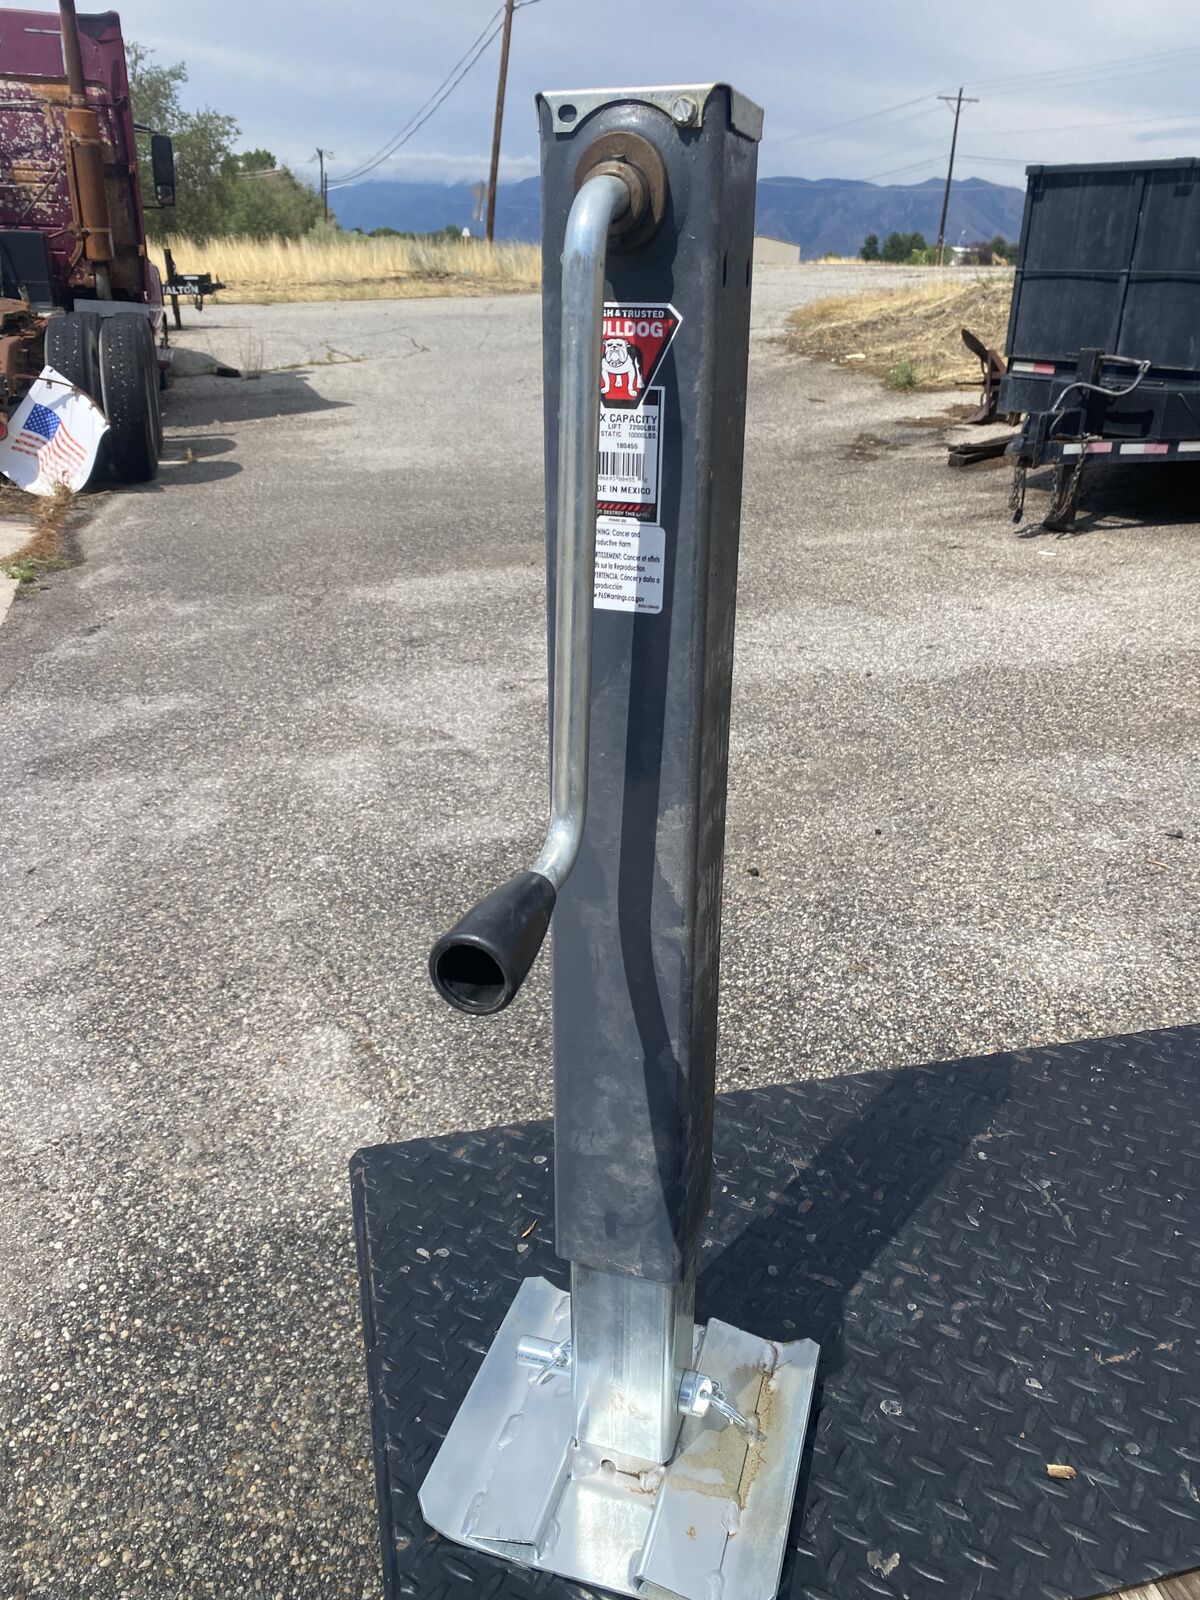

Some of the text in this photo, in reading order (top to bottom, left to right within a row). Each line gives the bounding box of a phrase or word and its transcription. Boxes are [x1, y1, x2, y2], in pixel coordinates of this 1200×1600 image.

[622, 310, 665, 319] TRUSTED
[609, 413, 657, 425] CAPACITY
[600, 430, 621, 438] STATIC
[609, 485, 618, 493] IN
[620, 486, 651, 495] MEXICO
[612, 529, 630, 538] Cancer
[614, 563, 645, 573] Reproduction
